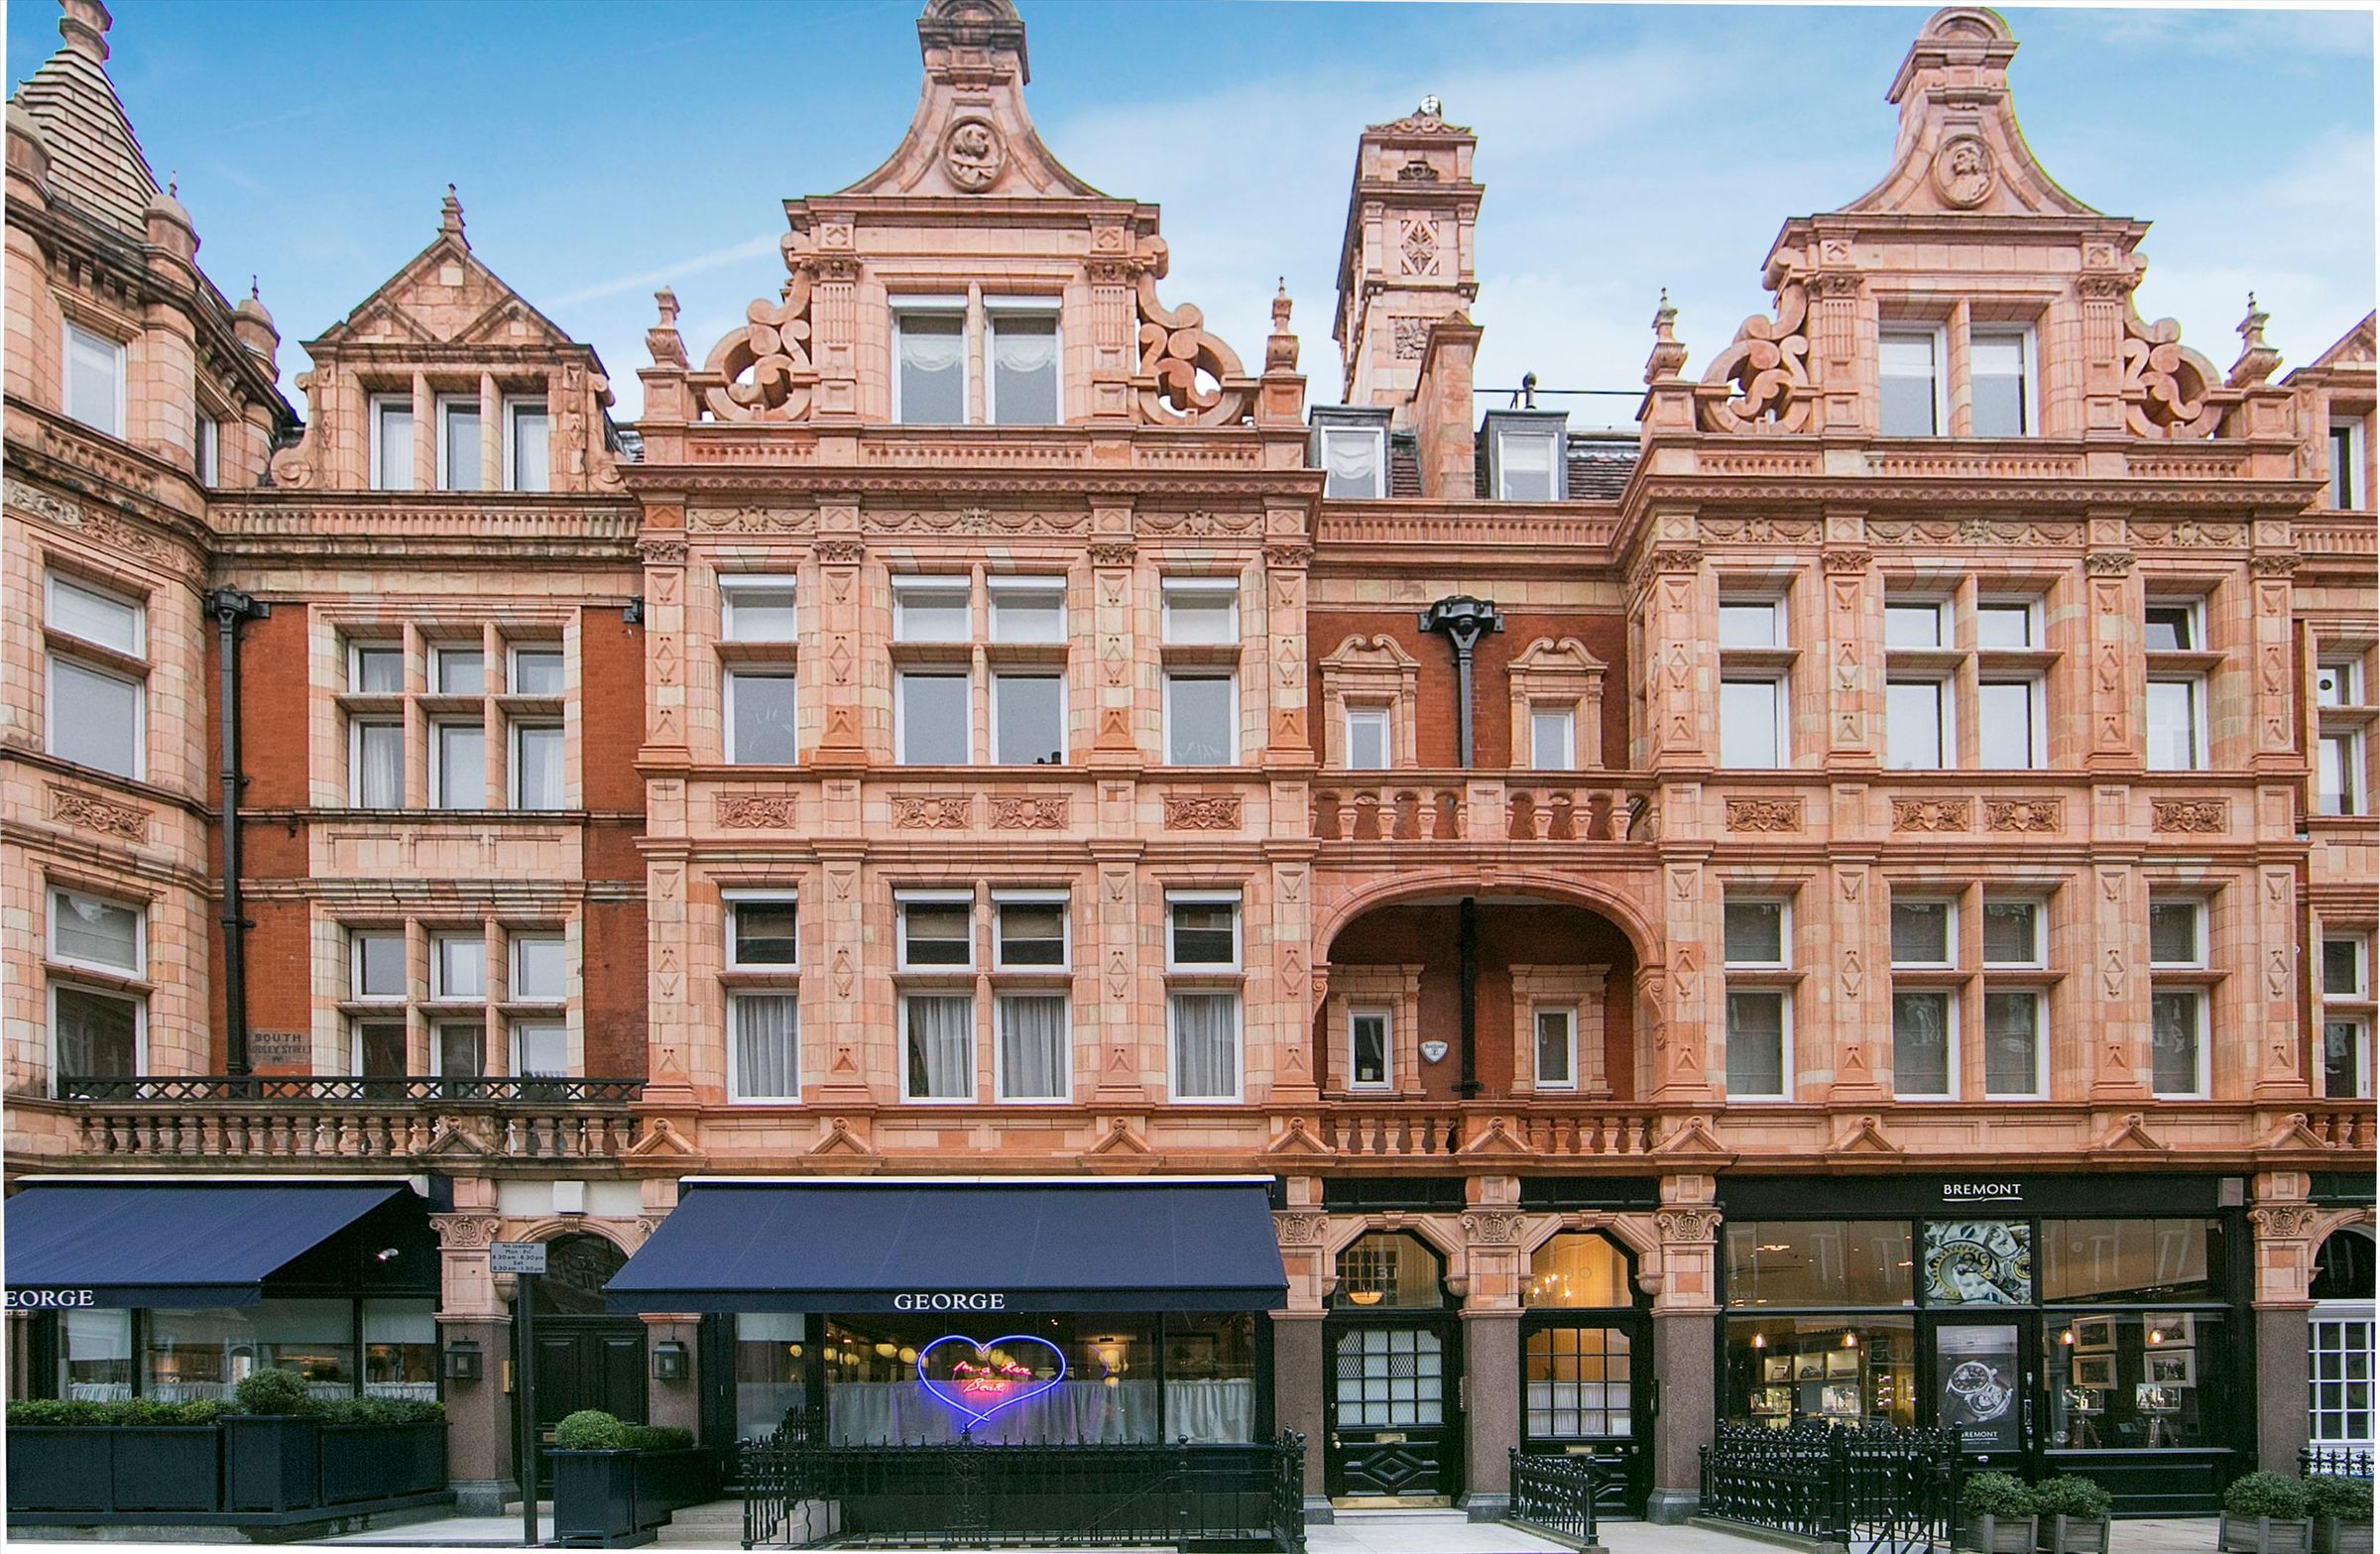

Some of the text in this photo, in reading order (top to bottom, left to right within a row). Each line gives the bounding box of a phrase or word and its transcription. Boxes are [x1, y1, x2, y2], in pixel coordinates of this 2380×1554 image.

[255, 1033, 301, 1042] SOUTH
[1944, 1183, 2022, 1195] BREMONT
[1376, 1267, 1396, 1279] 31
[893, 1293, 1006, 1310] GEORGE
